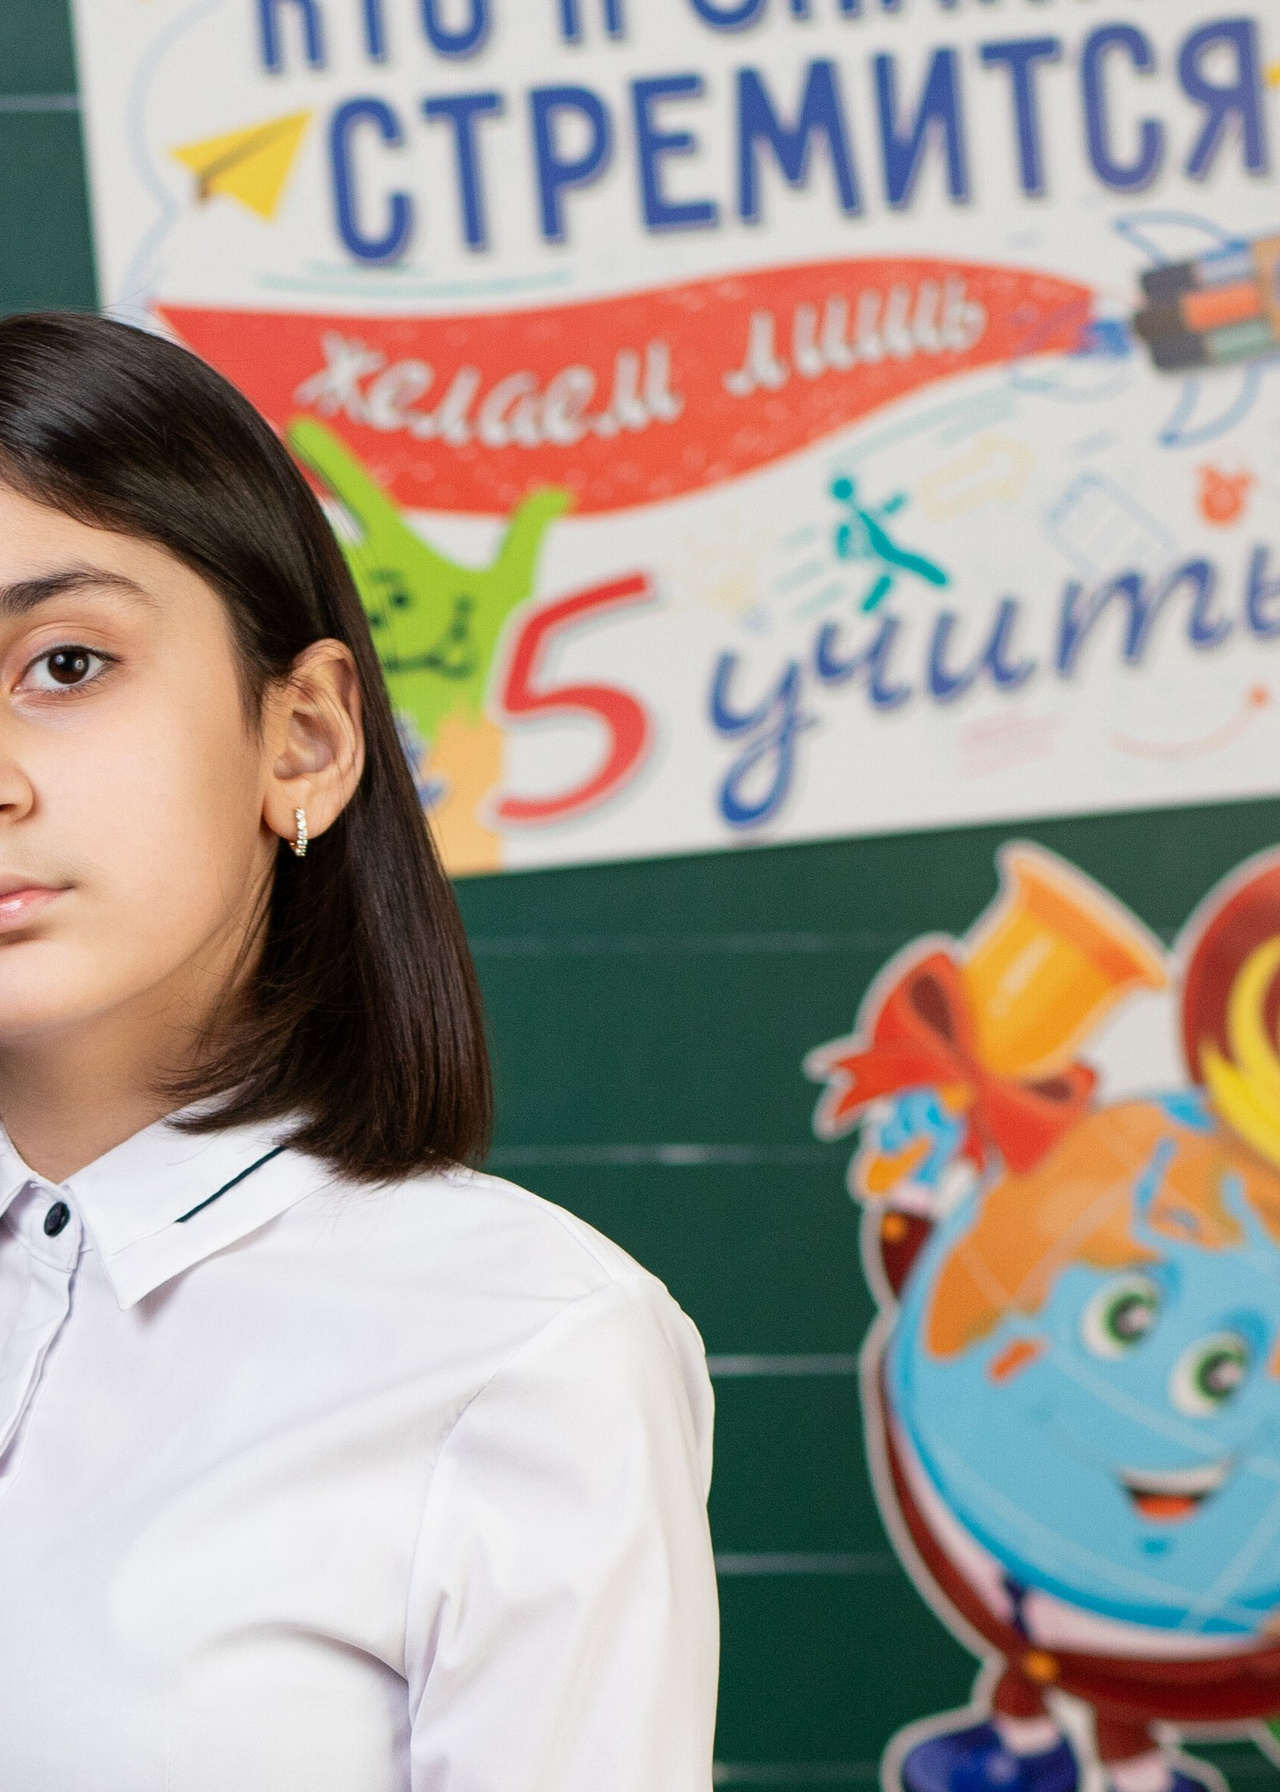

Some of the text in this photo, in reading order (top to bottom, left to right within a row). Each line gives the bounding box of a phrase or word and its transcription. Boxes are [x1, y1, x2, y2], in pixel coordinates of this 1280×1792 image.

[327, 17, 1268, 268] СТРЕМИТСЯ
[290, 273, 987, 448] желаем лишь
[496, 574, 650, 822] 5
